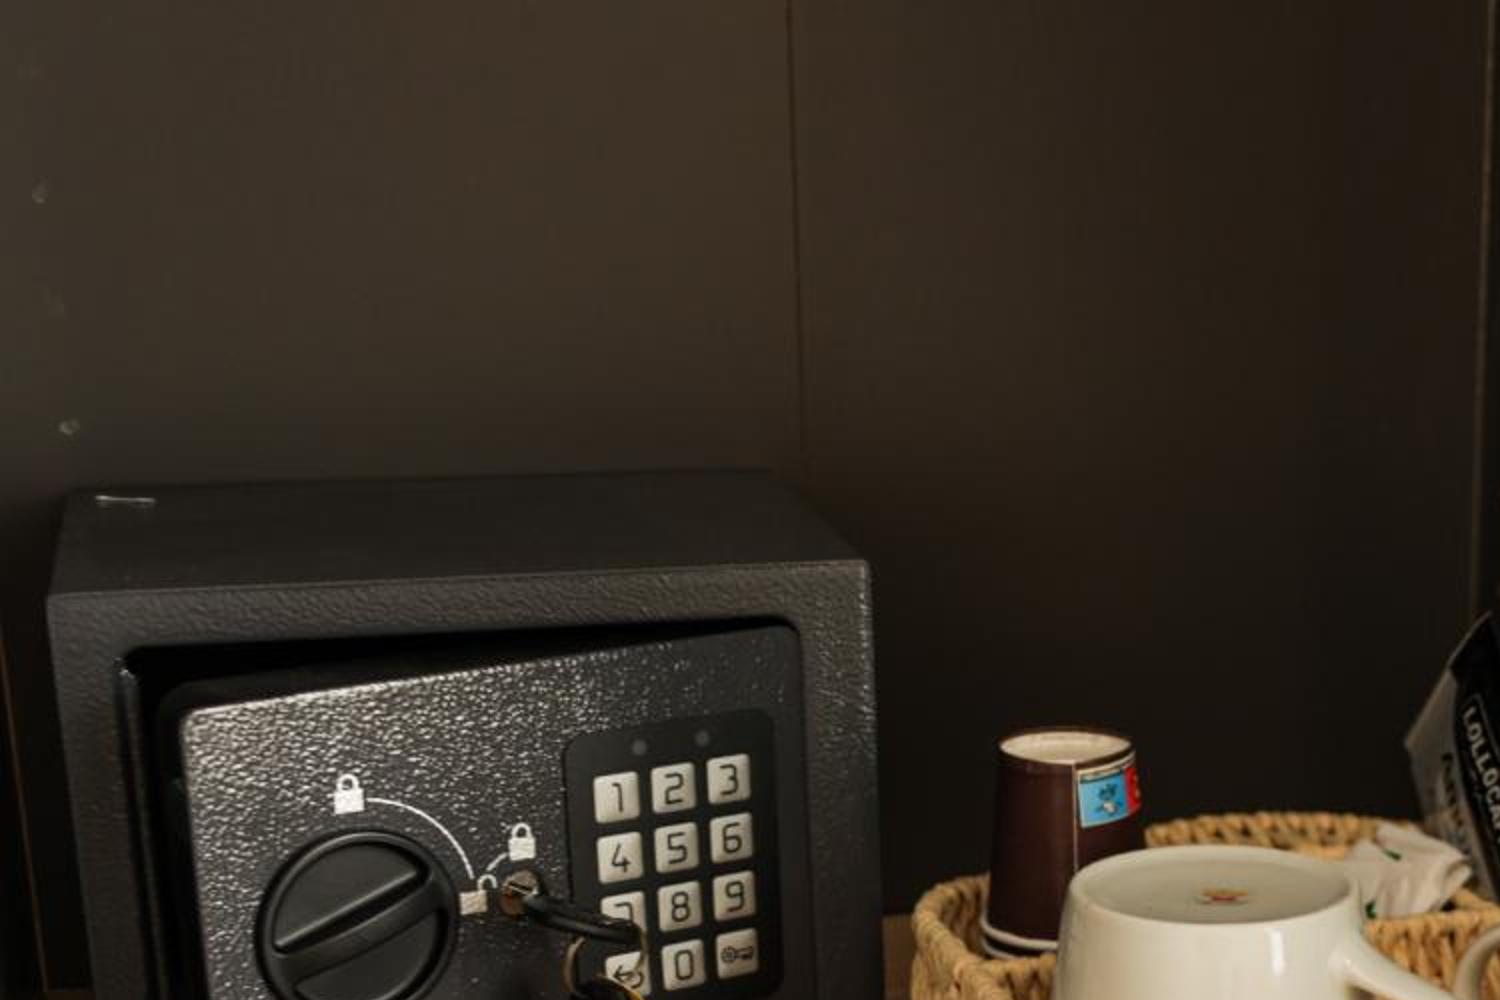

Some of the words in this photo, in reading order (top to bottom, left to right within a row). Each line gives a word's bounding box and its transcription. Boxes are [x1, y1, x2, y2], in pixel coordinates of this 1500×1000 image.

[611, 782, 624, 813] 1
[664, 772, 685, 805] 2
[719, 763, 739, 796] 3
[611, 843, 631, 873] 4
[667, 832, 688, 865] 5
[722, 822, 743, 854] 6
[671, 891, 691, 923] 8
[725, 880, 745, 913] 9
[674, 949, 695, 981] 0
